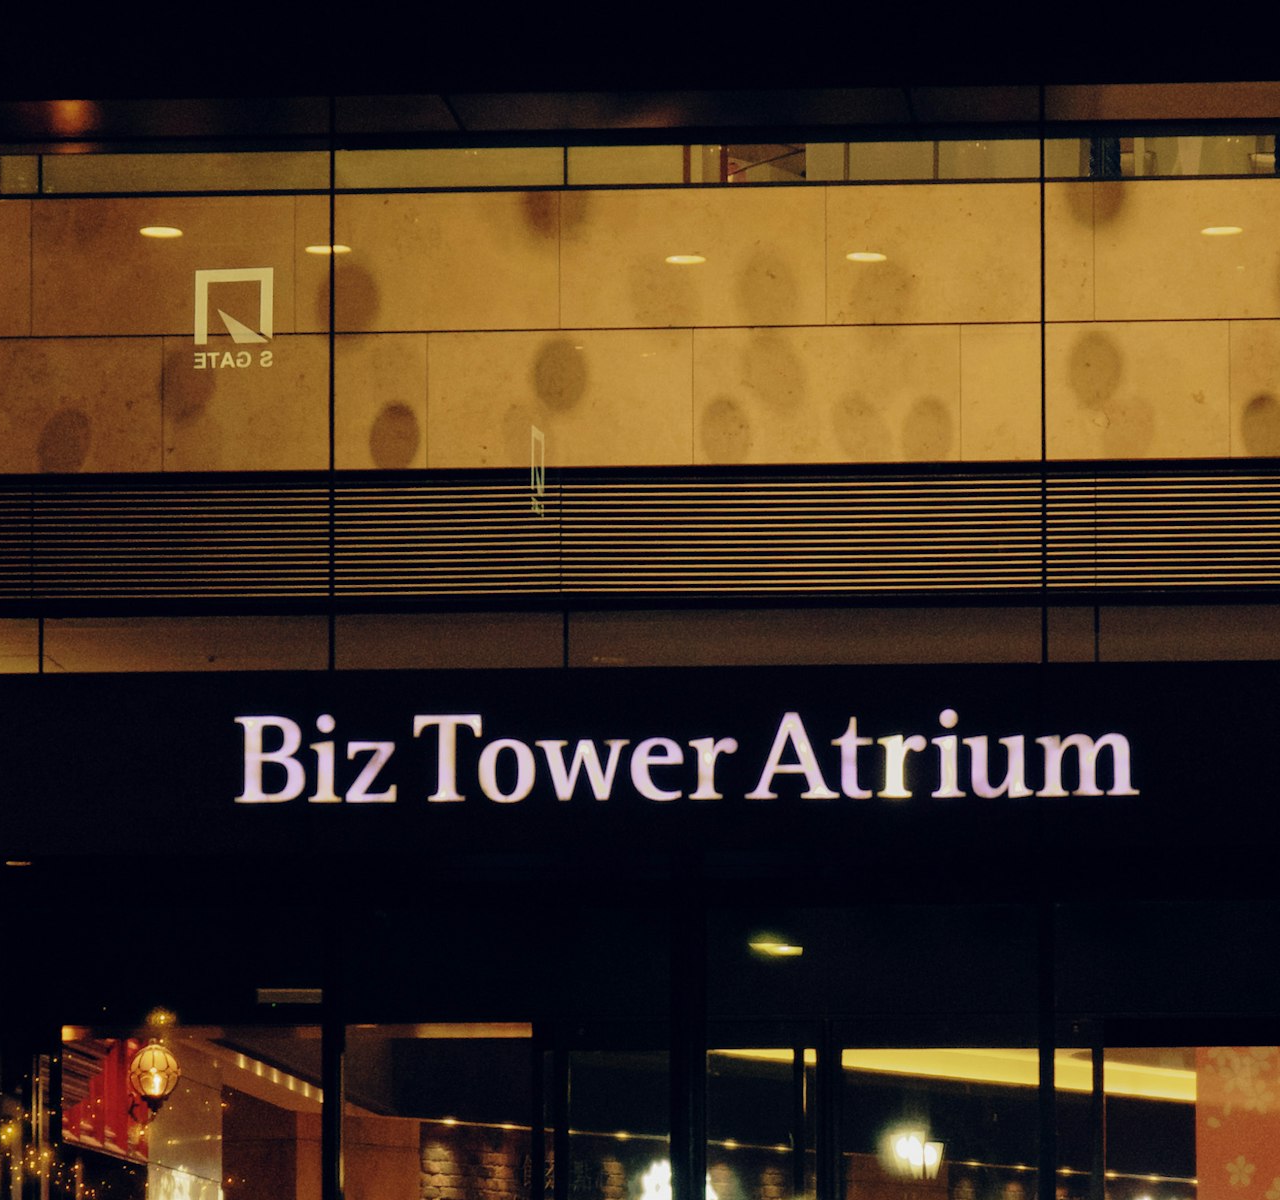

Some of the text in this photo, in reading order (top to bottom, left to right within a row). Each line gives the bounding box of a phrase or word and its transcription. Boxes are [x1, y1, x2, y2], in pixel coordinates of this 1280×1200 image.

[235, 709, 1139, 803] Biz Tower Atrium
